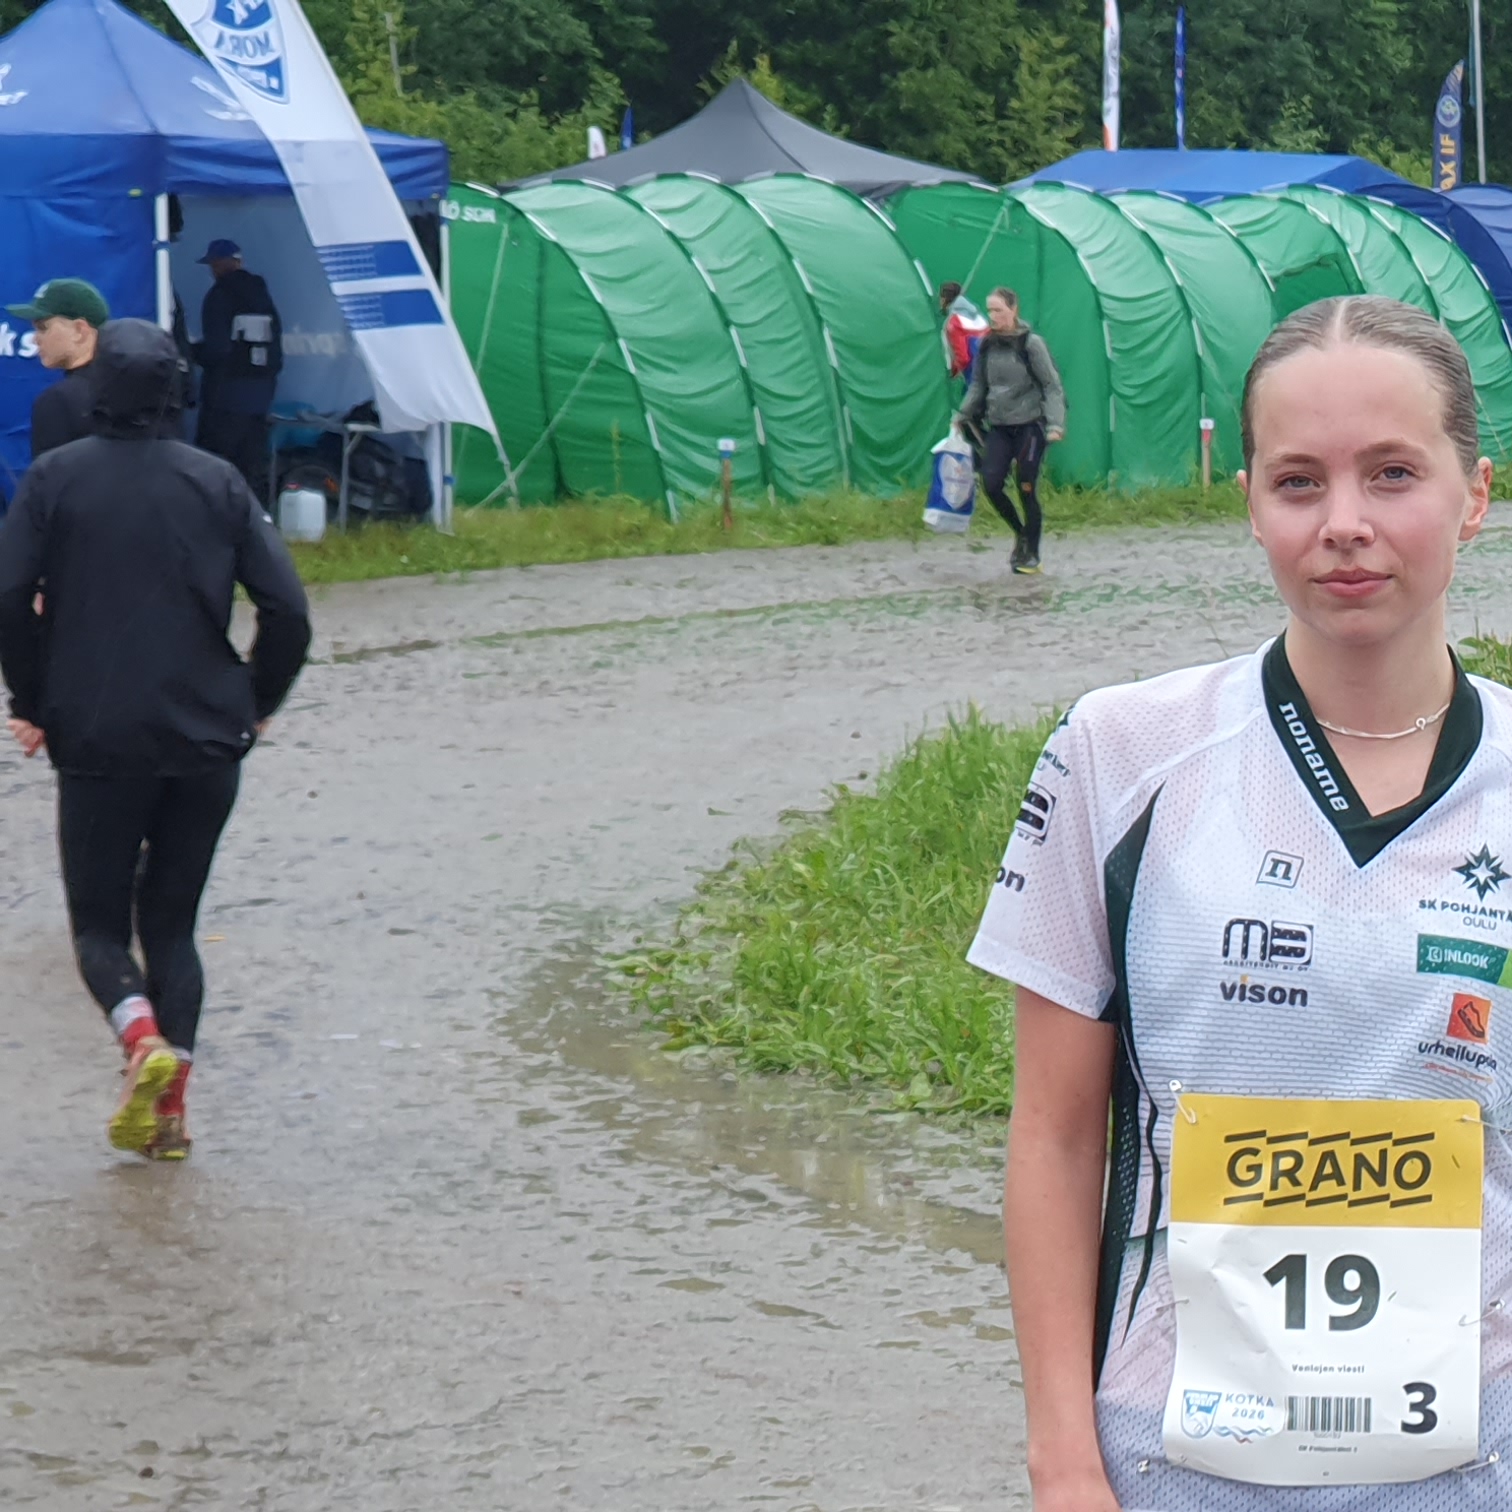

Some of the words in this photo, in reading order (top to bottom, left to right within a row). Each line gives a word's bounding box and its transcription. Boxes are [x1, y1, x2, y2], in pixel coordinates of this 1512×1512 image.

[1279, 702, 1350, 812] noname
[1418, 899, 1437, 911] SK
[1463, 916, 1497, 931] OULU
[1220, 974, 1308, 1007] vison
[1226, 1146, 1433, 1193] GRANO
[1263, 1253, 1381, 1332] 19
[1225, 1393, 1275, 1408] KOTKA
[1232, 1408, 1265, 1420] 2026
[1400, 1382, 1438, 1434] 3
